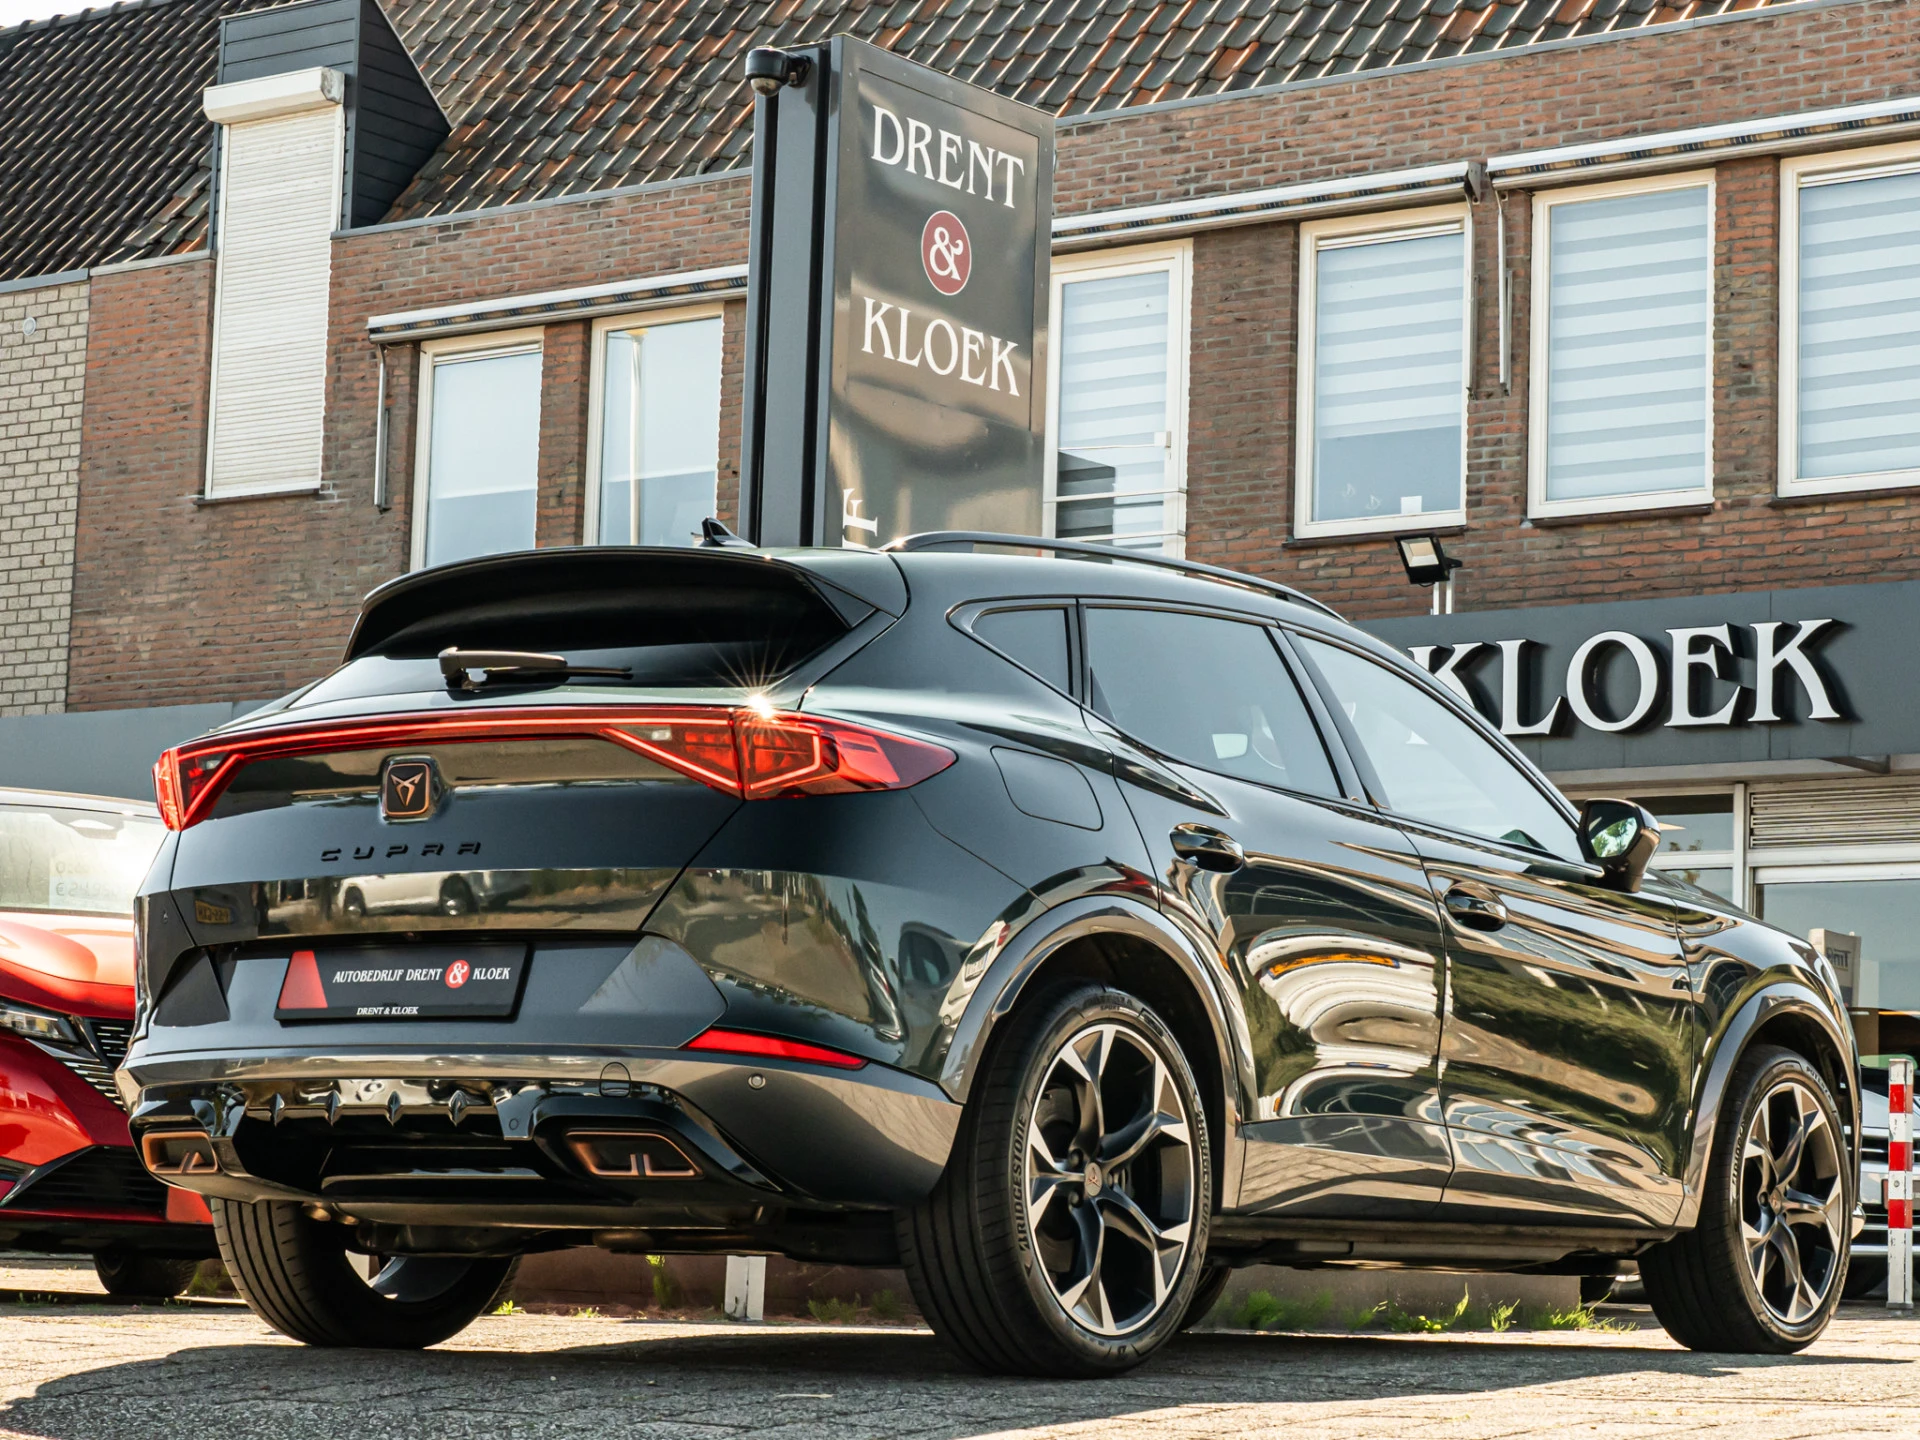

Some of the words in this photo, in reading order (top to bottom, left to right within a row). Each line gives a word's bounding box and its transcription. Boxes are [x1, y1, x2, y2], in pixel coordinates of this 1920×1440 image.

[870, 104, 1025, 209] DRENT
[929, 226, 965, 282] &
[861, 297, 1021, 398] KLOEK
[1407, 619, 1841, 735] KLOEK
[321, 841, 482, 862] CUPRA
[332, 969, 404, 983] AUTOBEDRIJF
[405, 968, 443, 982] DRENT
[449, 962, 468, 984] &
[472, 967, 511, 980] KLOEK
[356, 1007, 383, 1016] DRENT
[383, 1007, 390, 1015] &
[391, 1006, 419, 1015] KLOEK
